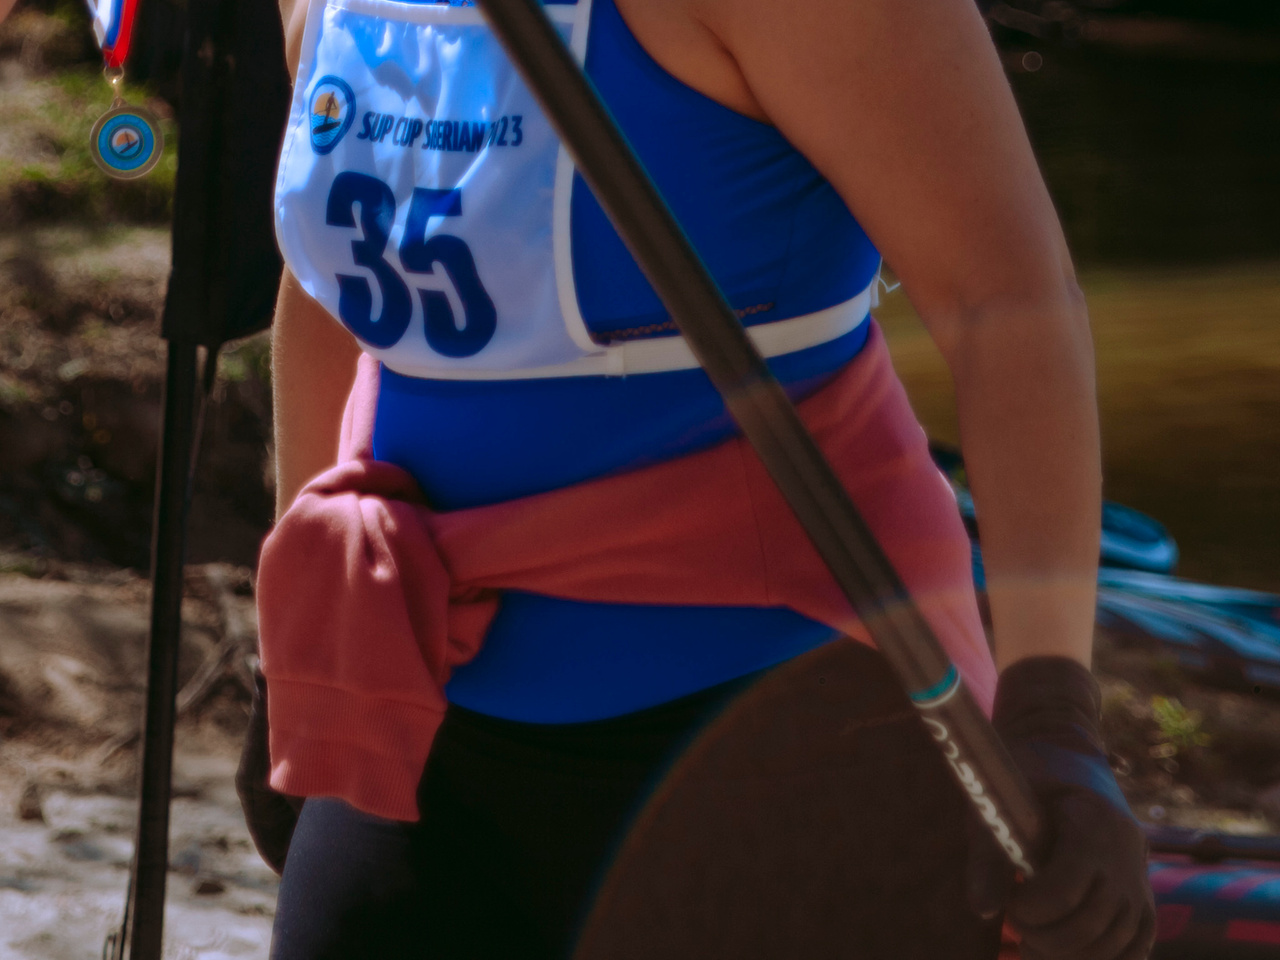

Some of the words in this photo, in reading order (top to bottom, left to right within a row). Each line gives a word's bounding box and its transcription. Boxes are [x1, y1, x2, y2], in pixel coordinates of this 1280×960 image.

[356, 110, 395, 144] SUP
[393, 116, 423, 148] CUP
[325, 171, 497, 358] 35
